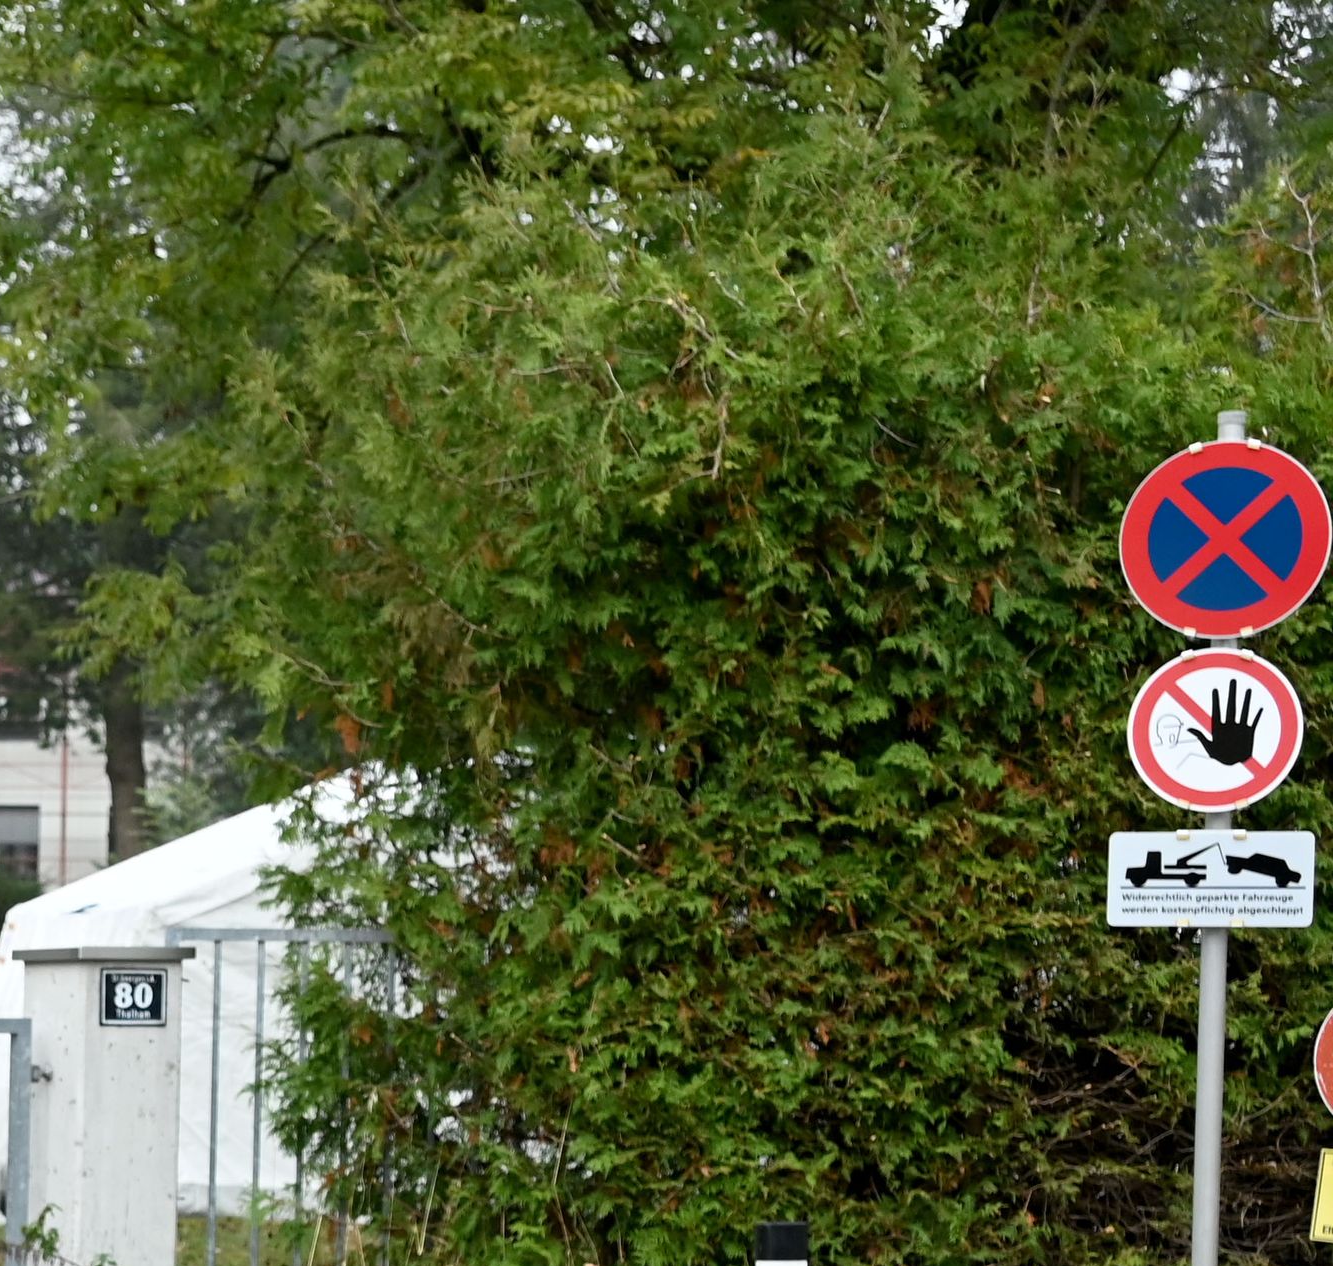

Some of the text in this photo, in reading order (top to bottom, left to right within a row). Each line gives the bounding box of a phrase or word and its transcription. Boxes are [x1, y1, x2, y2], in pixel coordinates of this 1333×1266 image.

[1122, 893, 1294, 904] Widerrechtlich geparkte Fahrzeuge
[1121, 906, 1304, 916] werden kostenpflichtig abgeschleppt
[114, 982, 153, 1009] 80
